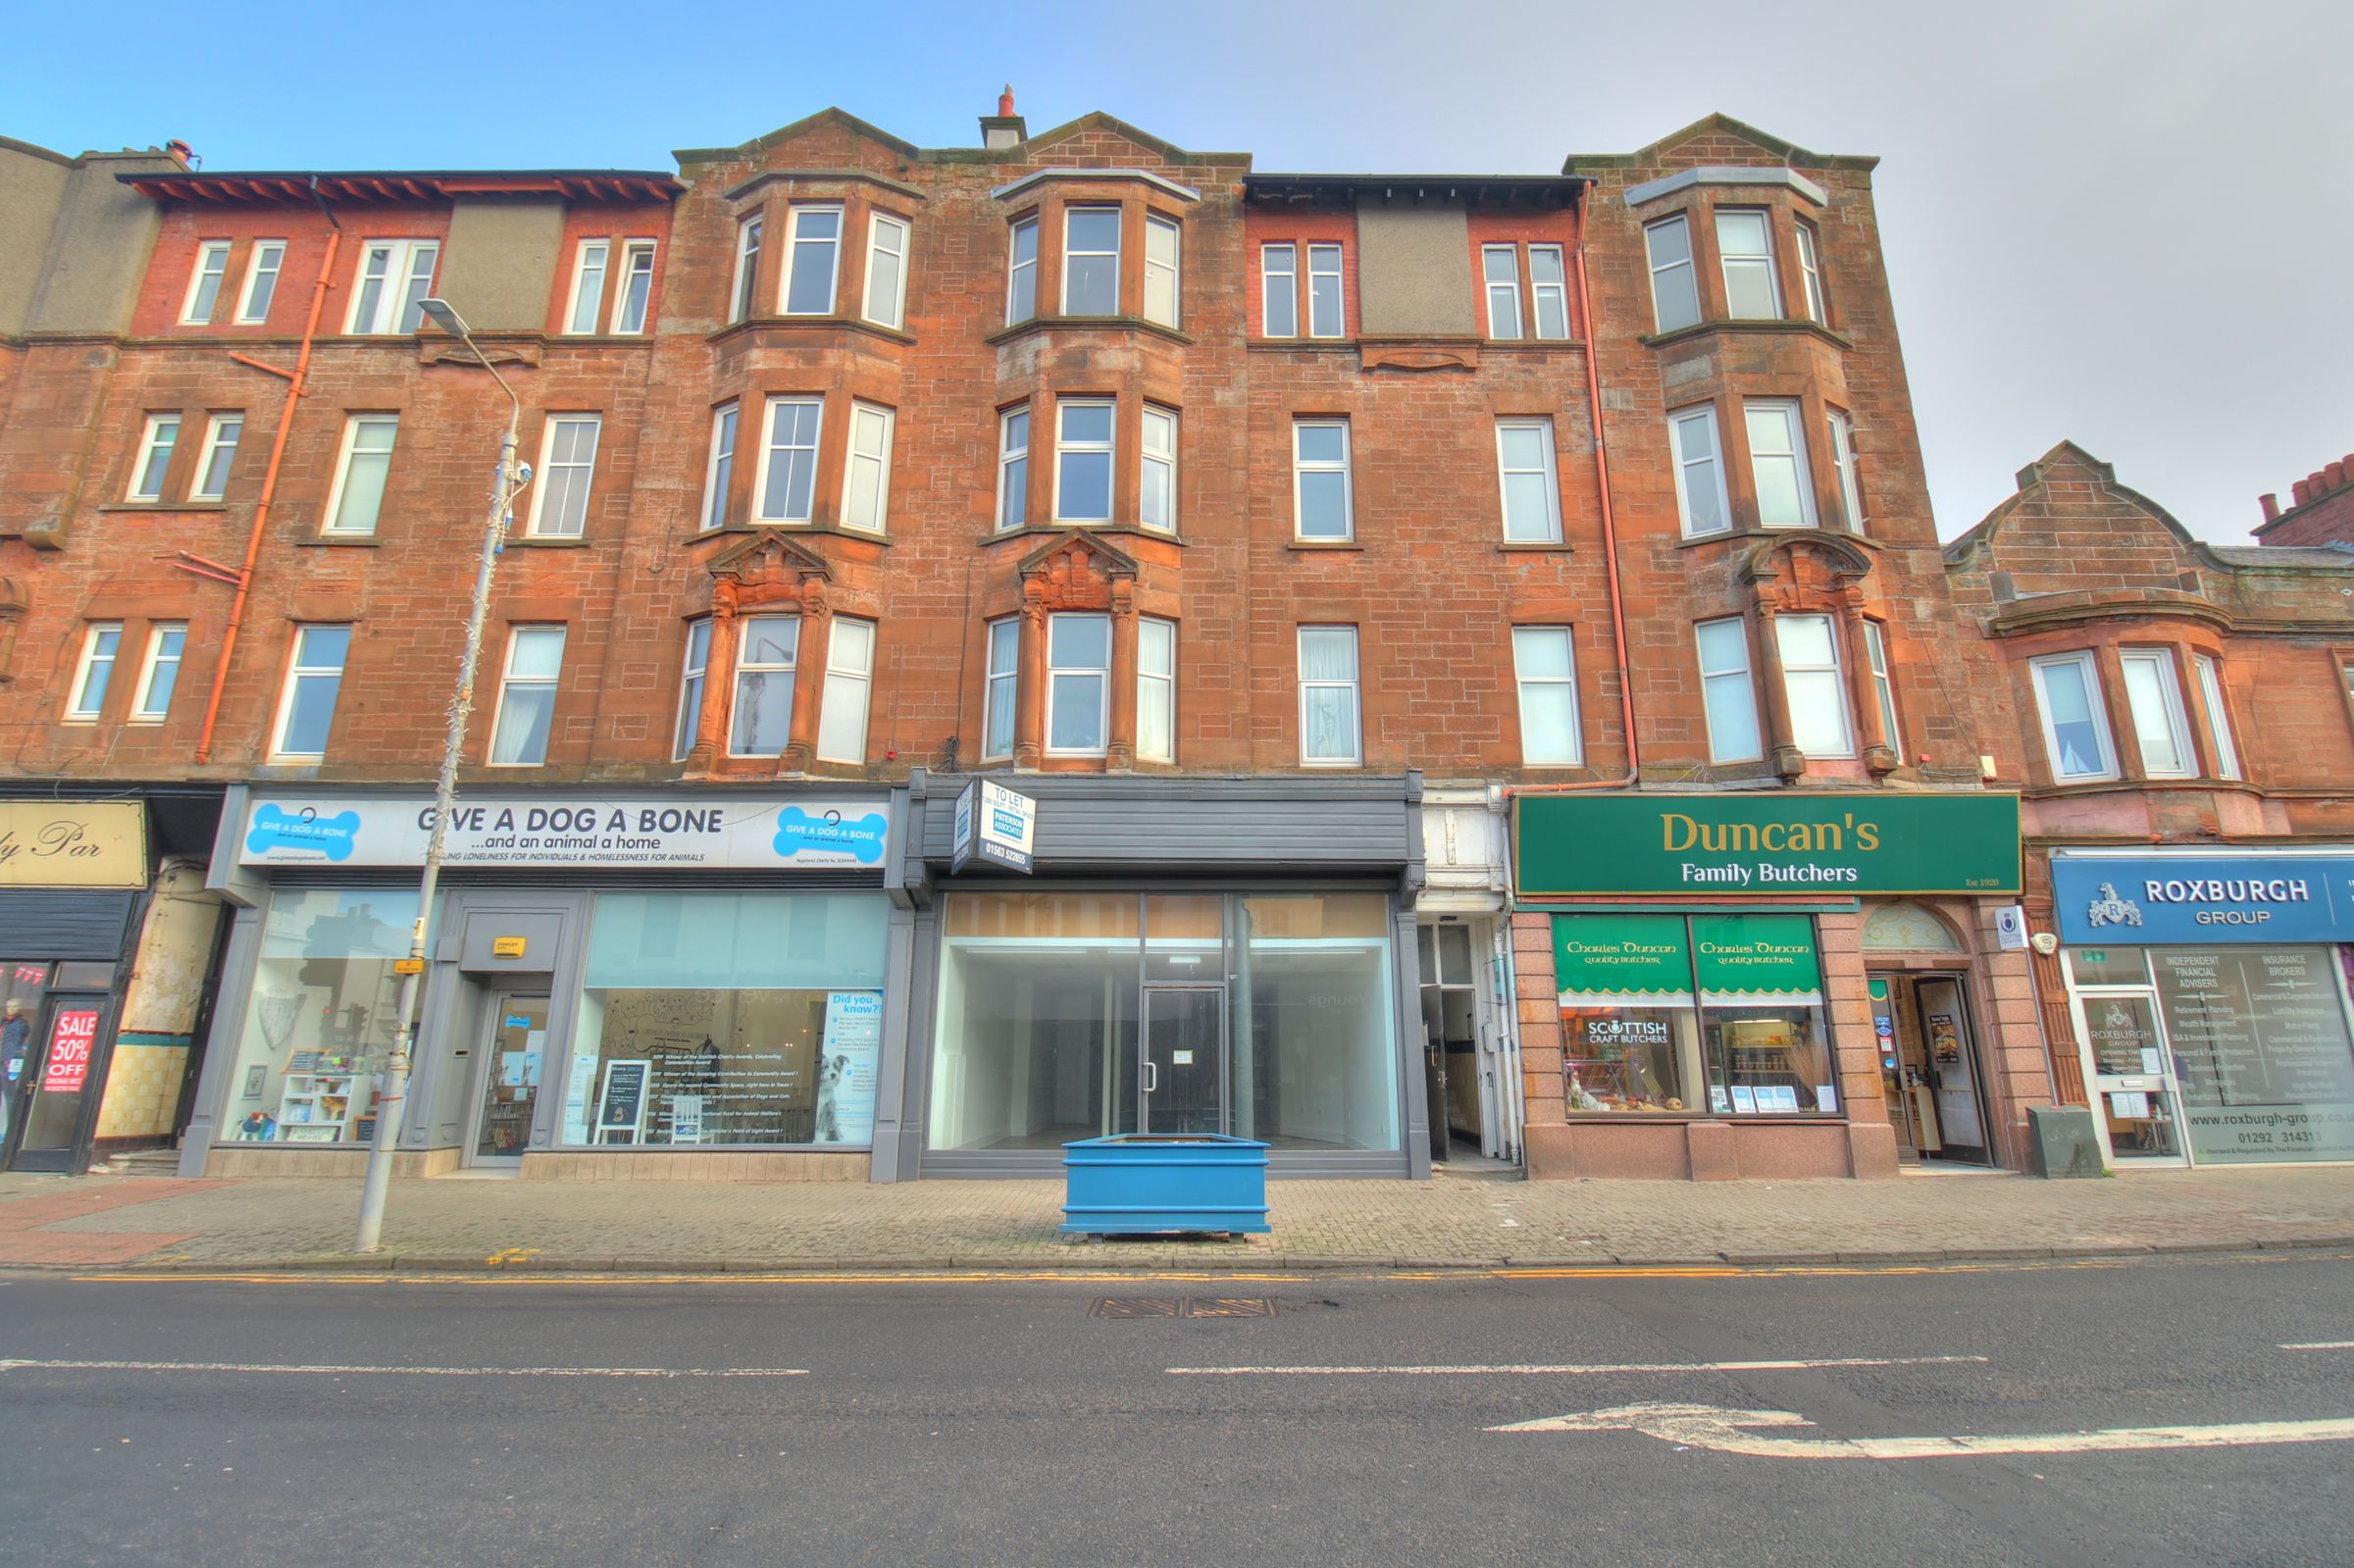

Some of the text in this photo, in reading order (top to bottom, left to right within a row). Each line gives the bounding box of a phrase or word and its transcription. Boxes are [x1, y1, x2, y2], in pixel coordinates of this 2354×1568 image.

[995, 786, 1024, 809] TO LET
[418, 807, 724, 833] GVE A DOG A BONE
[261, 822, 282, 831] GIVE
[291, 825, 312, 834] DOG
[323, 828, 347, 837] BONE
[787, 825, 806, 834] GIVE
[817, 828, 839, 836] DOG
[849, 831, 875, 840] BONE
[1660, 813, 1880, 851] Duncan's
[30, 820, 102, 857] Par
[520, 839, 539, 848] an
[543, 835, 598, 849] animal
[601, 838, 612, 849] a
[616, 835, 661, 849] home
[463, 852, 508, 861] LONELINESS
[530, 853, 578, 862] INDIVIDUALS
[588, 853, 648, 862] HOMELESSNESS
[650, 853, 667, 862] FOR
[668, 853, 705, 862] ANIMALS
[1681, 863, 1858, 886] Family Butchers
[1966, 878, 2000, 886] Est 1920
[2144, 879, 2309, 902] ROXBURGH
[2195, 910, 2272, 925] GROUP
[1567, 941, 1676, 953] Charles Duncan
[1700, 941, 1810, 953] Charles Duncan
[2166, 956, 2221, 965] INDEPENDENT
[2262, 955, 2307, 964] INSURANCE
[2175, 967, 2217, 977] FINANCIAL
[2268, 966, 2307, 976] BROKERS
[2179, 979, 2219, 987] ADVISERS
[834, 994, 873, 1006] Did you
[57, 1016, 97, 1037] SALE
[1588, 1020, 1666, 1035] SCOTTISH
[1589, 1035, 1667, 1043] CRAFT BUTCHERS
[2090, 1030, 2152, 1039] ROXBURGH
[52, 1039, 88, 1061] 50%
[48, 1064, 85, 1076] OFF
[2237, 1131, 2323, 1143] 01292 314313
